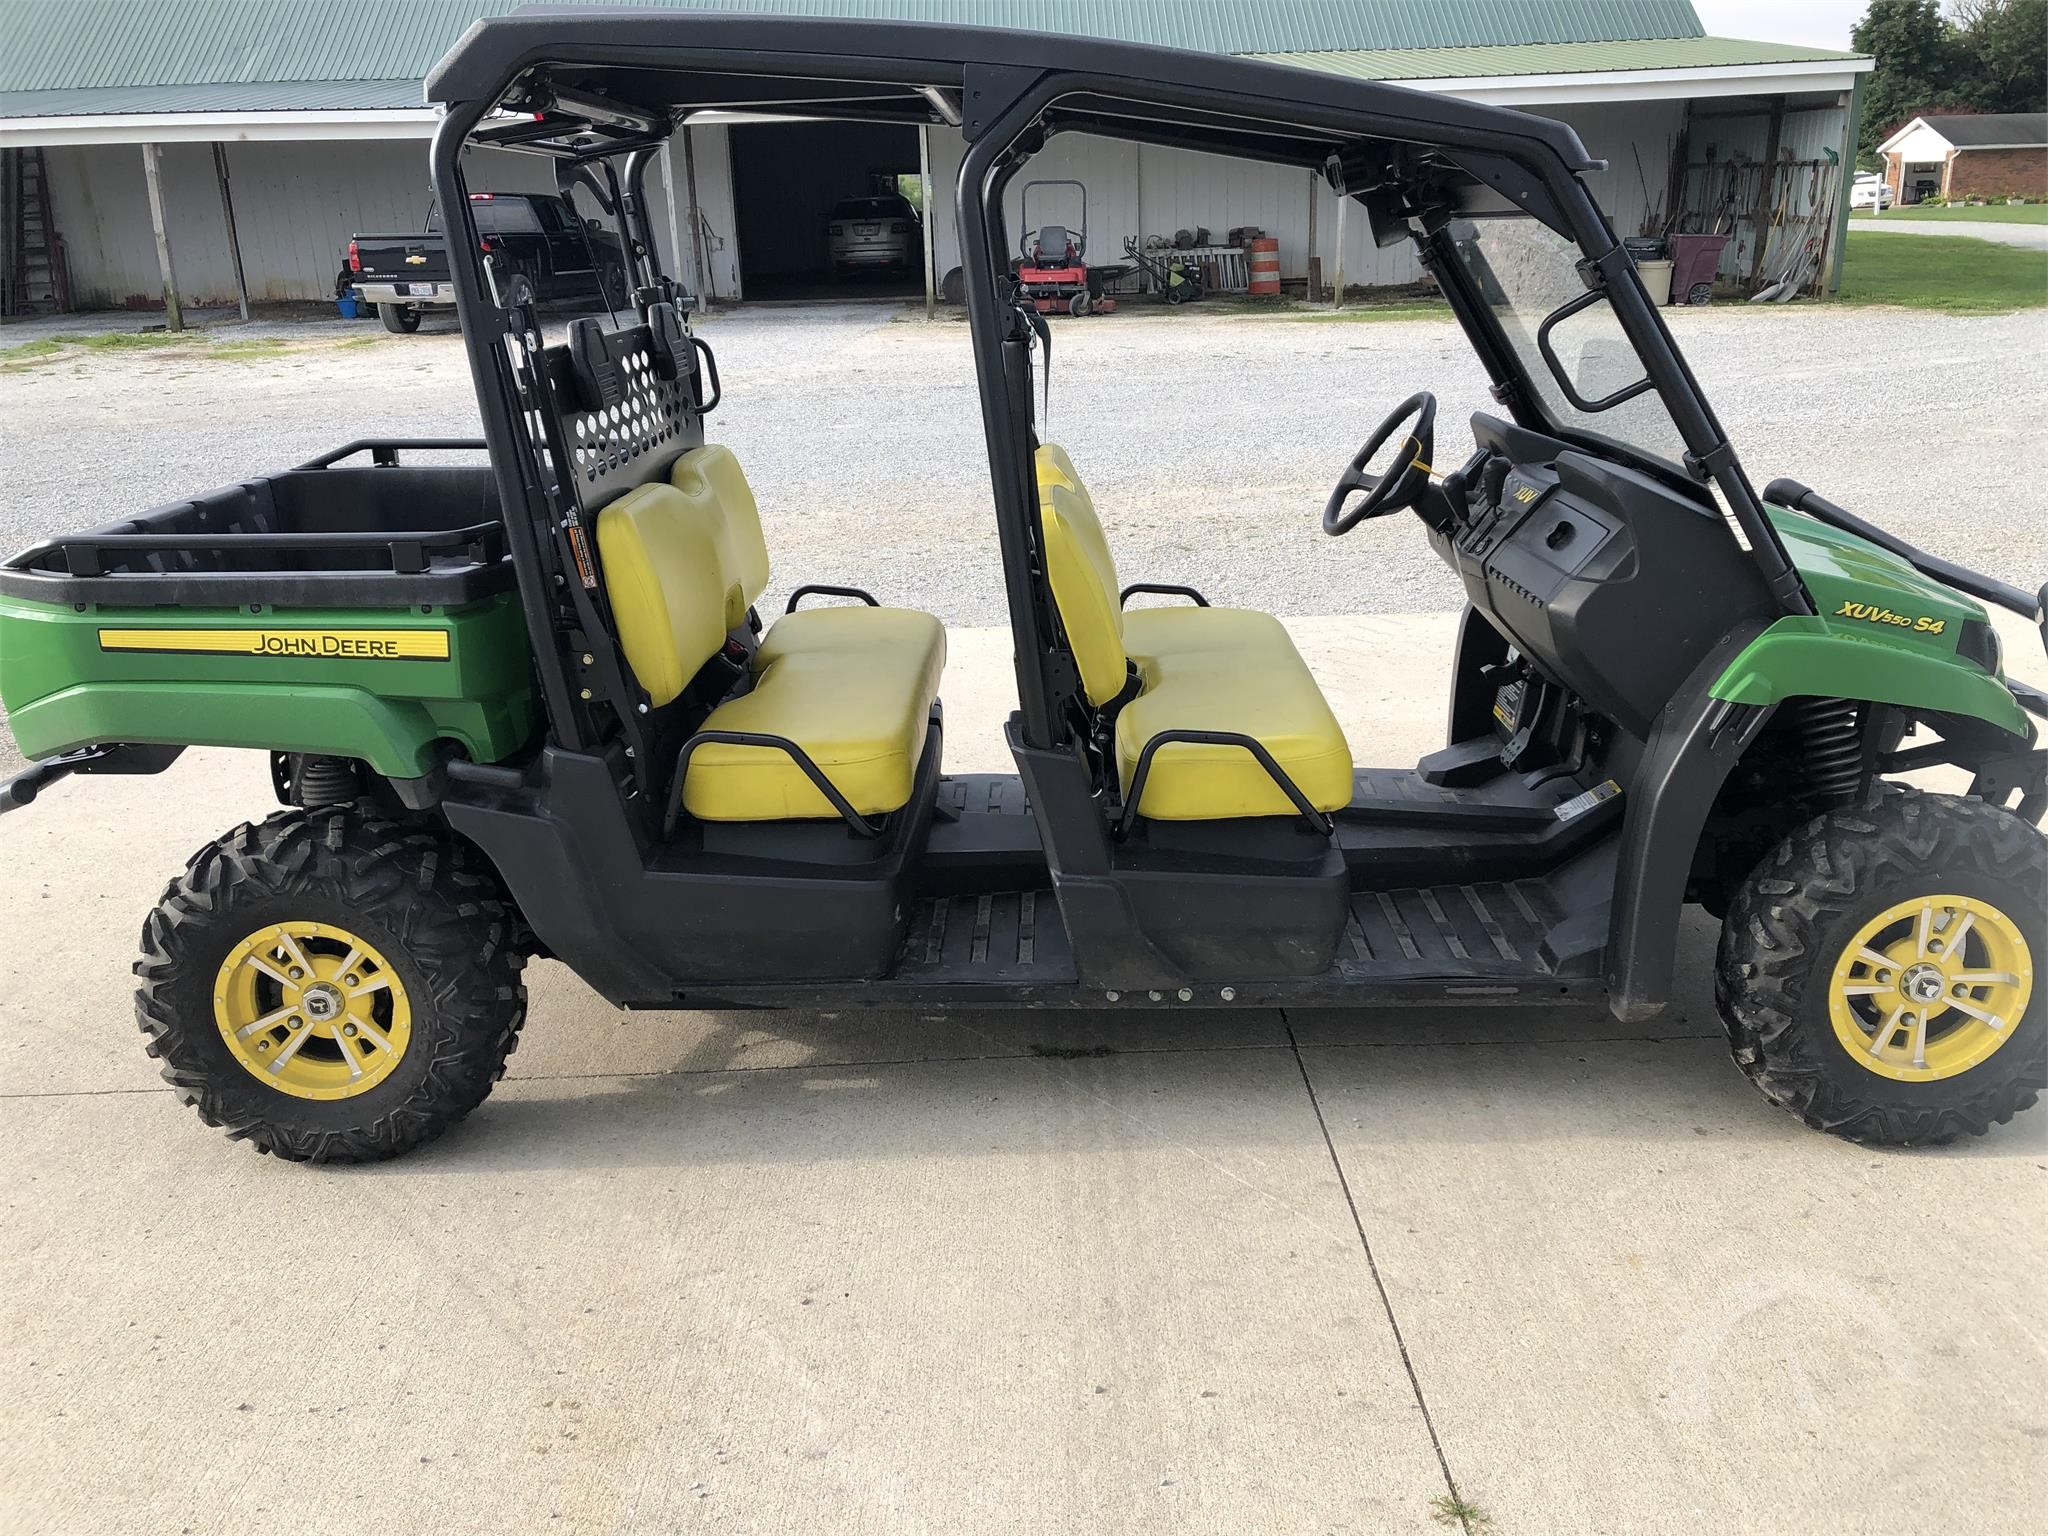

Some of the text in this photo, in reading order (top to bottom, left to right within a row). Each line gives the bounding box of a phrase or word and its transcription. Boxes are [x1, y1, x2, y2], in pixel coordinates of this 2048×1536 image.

[1512, 485, 1539, 503] XUV
[1834, 600, 1946, 635] XUV550 S4
[254, 634, 399, 655] JOHN DEERE
